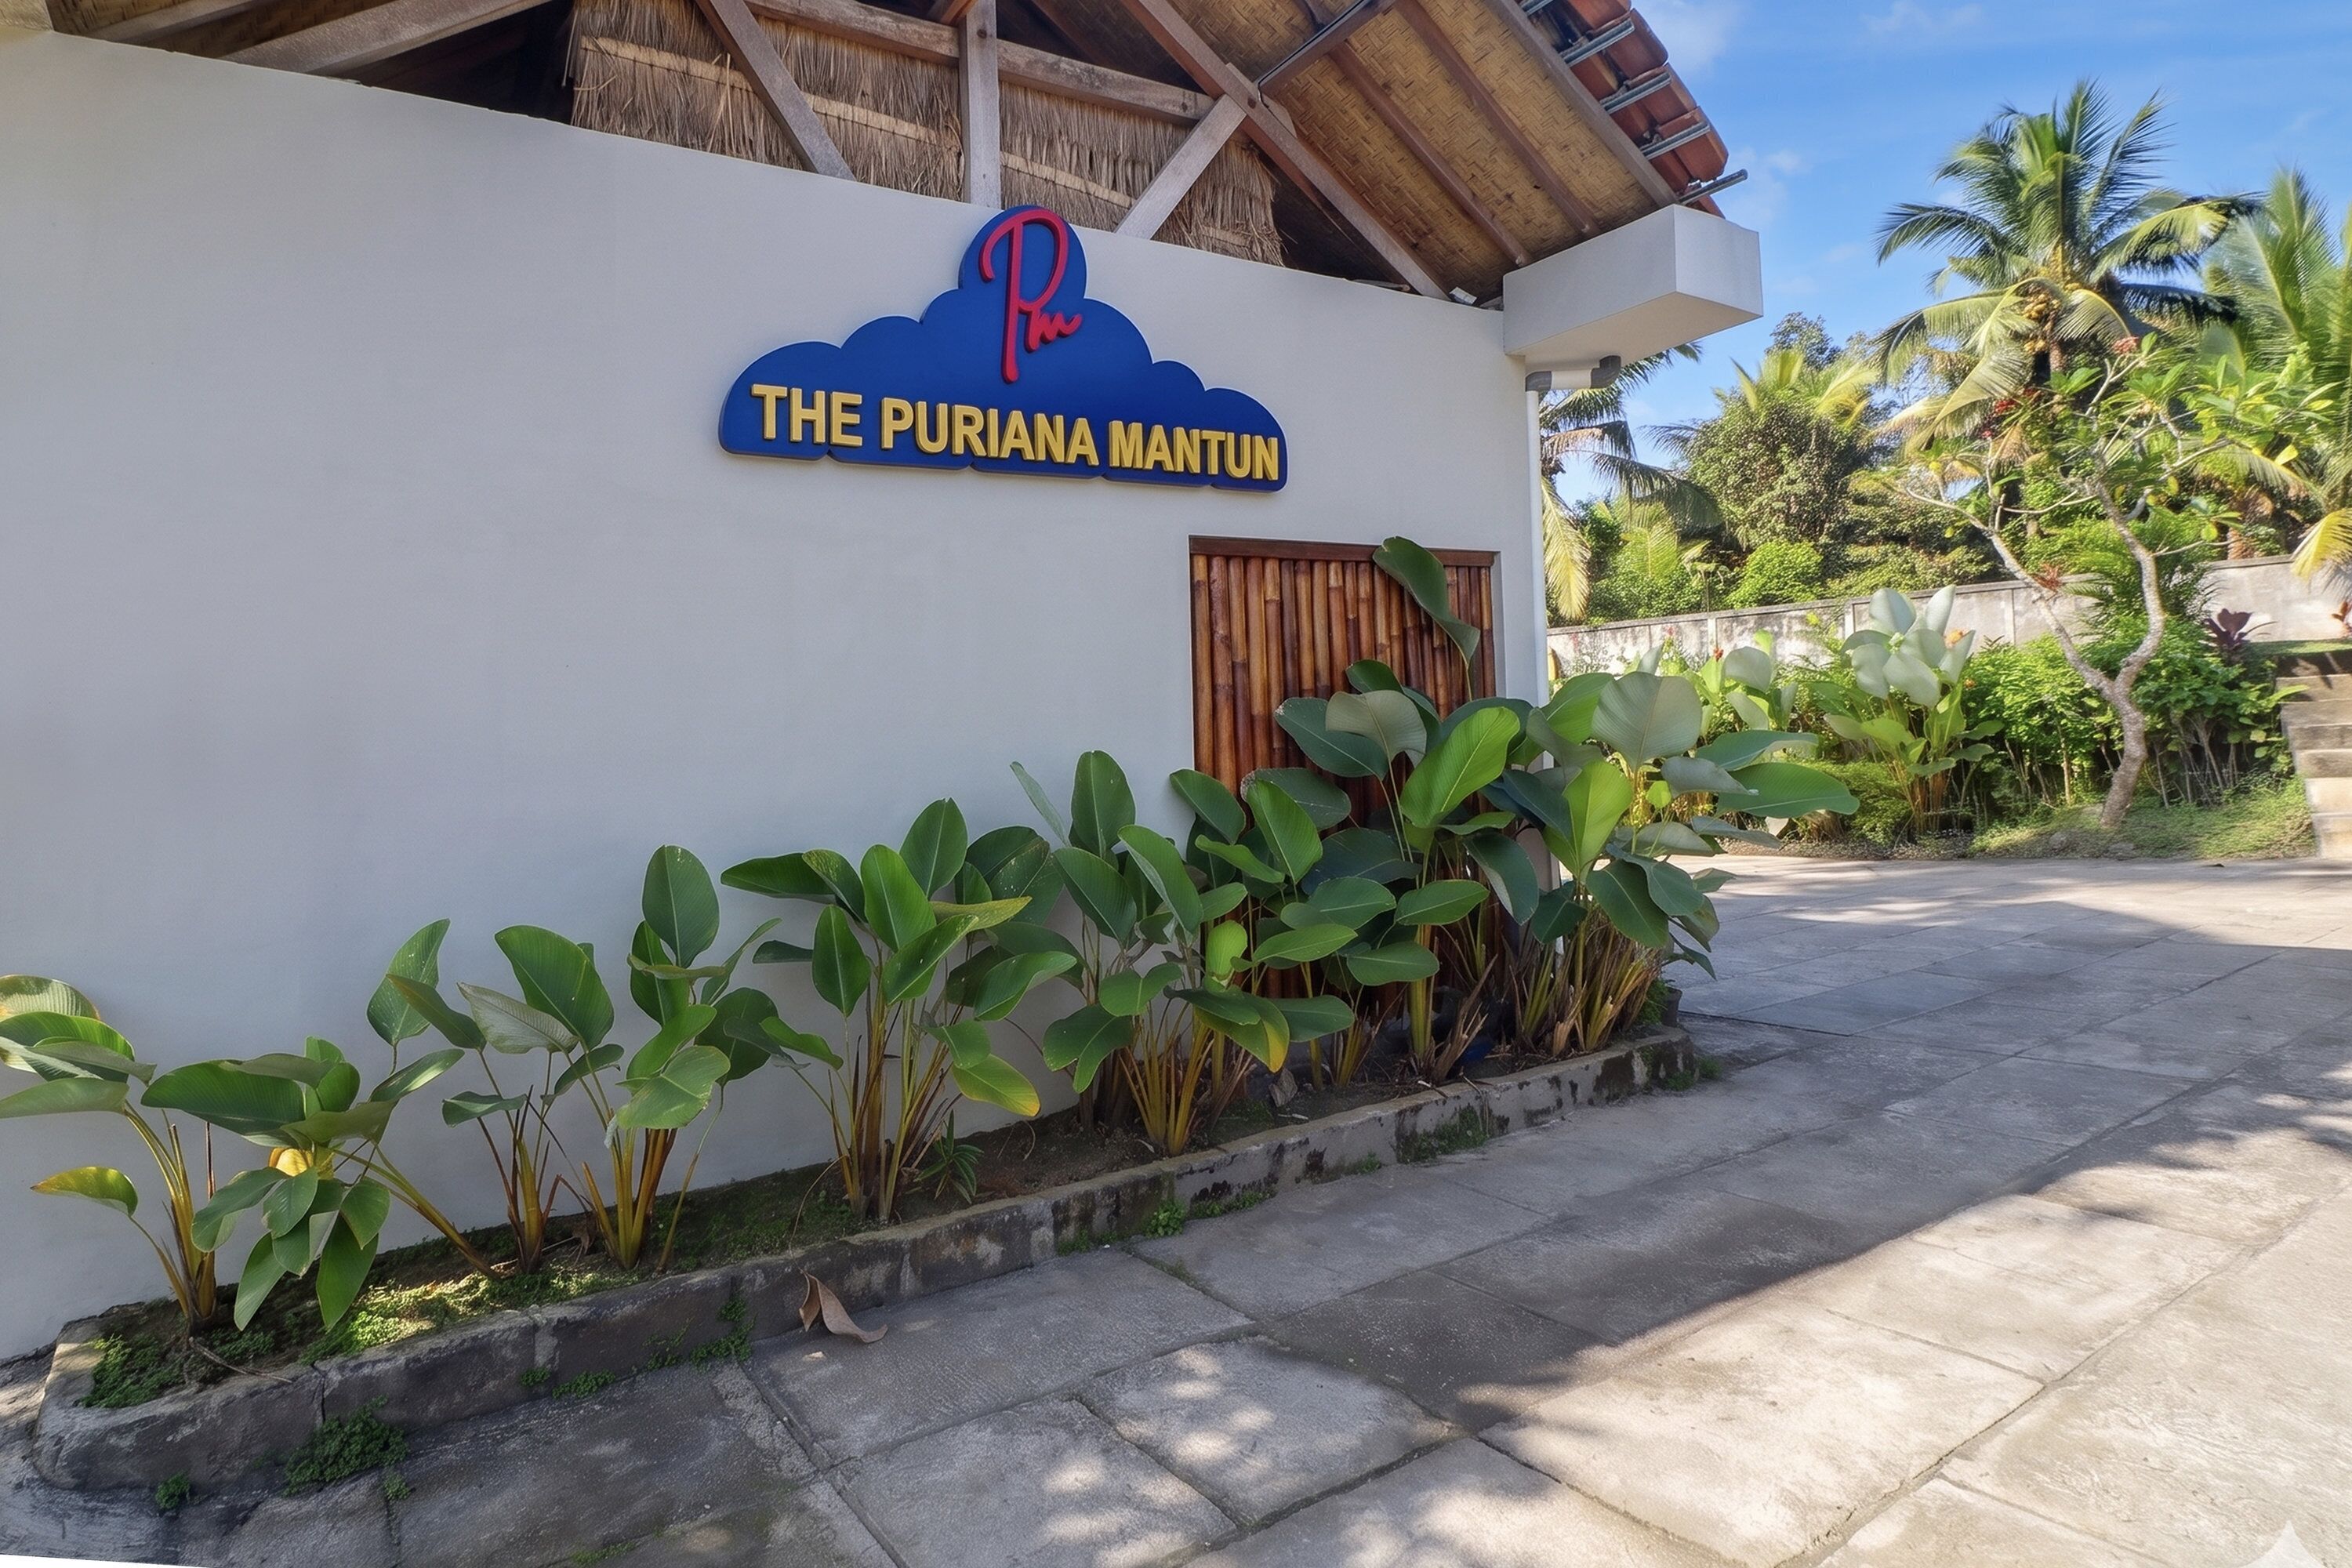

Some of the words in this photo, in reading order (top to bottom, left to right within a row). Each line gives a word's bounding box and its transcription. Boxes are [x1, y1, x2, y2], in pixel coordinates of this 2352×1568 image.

[750, 383, 863, 448] THE
[880, 397, 1099, 466] PURIANA
[1108, 419, 1279, 481] MANTUN
